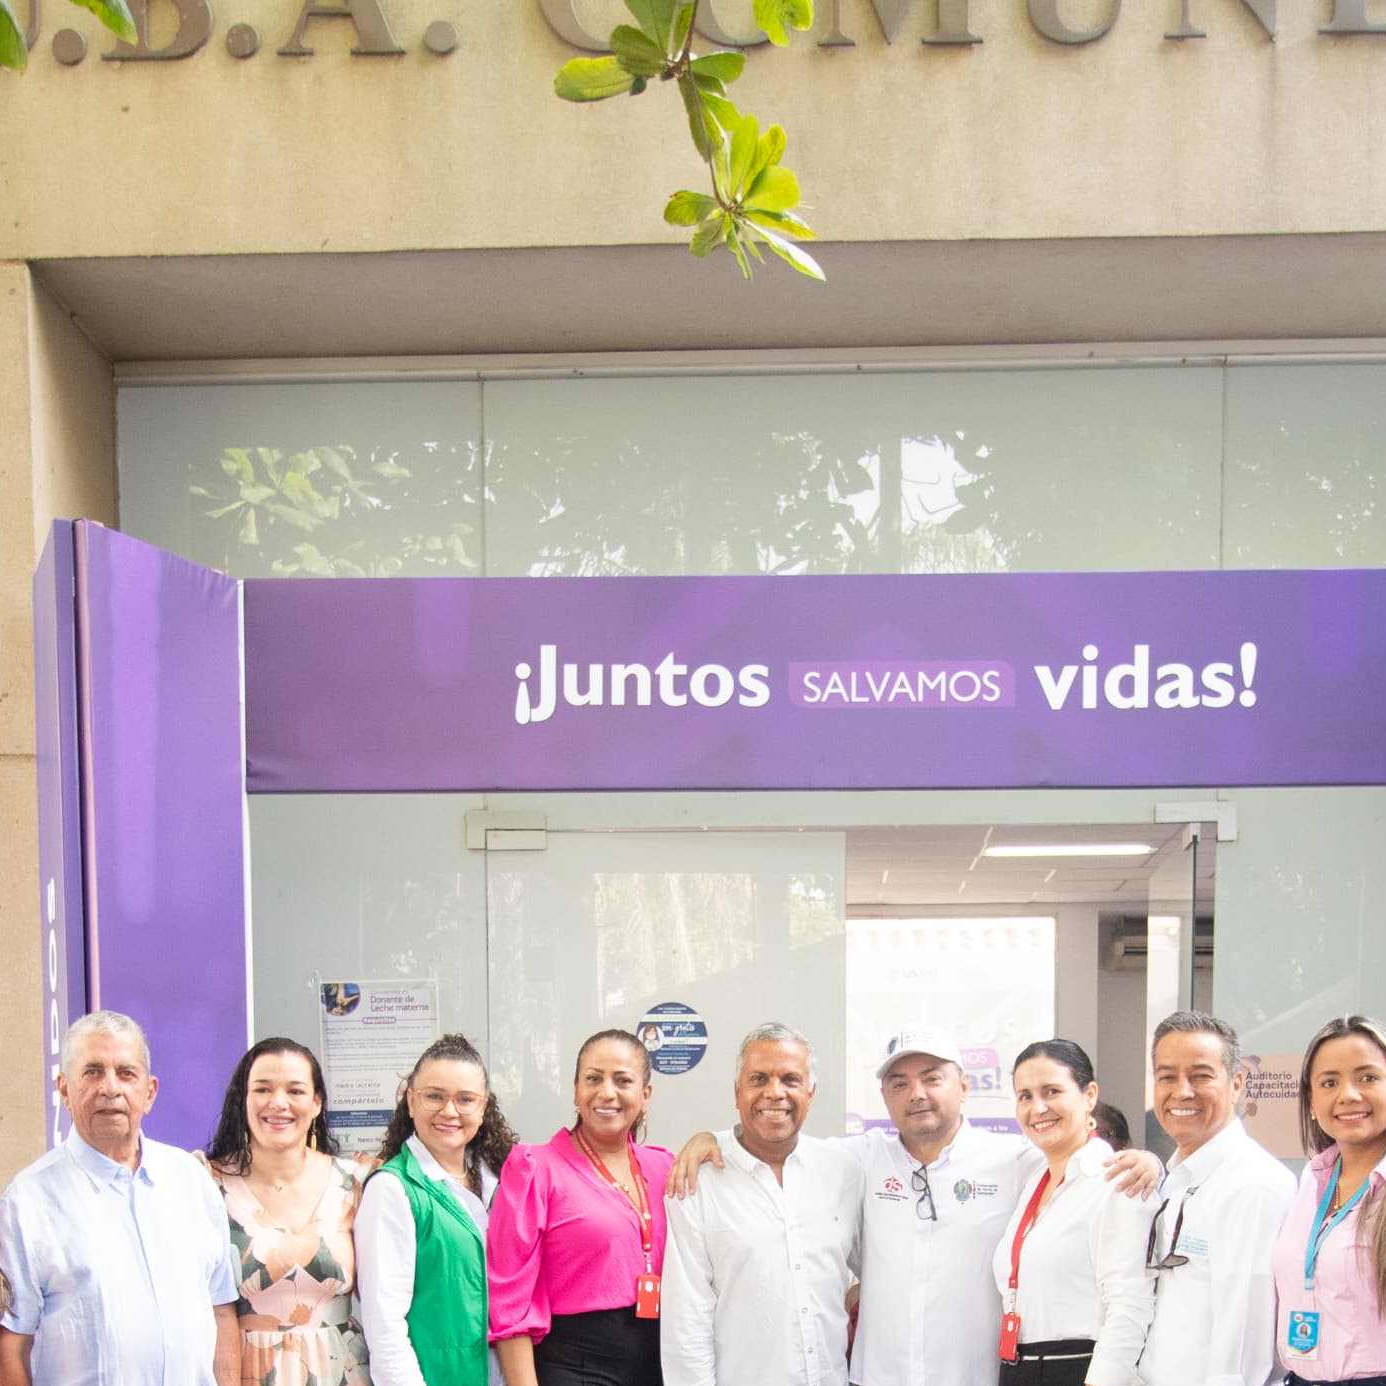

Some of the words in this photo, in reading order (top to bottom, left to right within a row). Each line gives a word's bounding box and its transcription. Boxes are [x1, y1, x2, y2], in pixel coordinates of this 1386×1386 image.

[515, 644, 771, 725] ¡Juntos
[803, 670, 1001, 703] SALVAMOS
[1034, 642, 1258, 710] vidas!
[1246, 1072, 1293, 1080] Auditorio
[1245, 1080, 1300, 1091] Capacitaci
